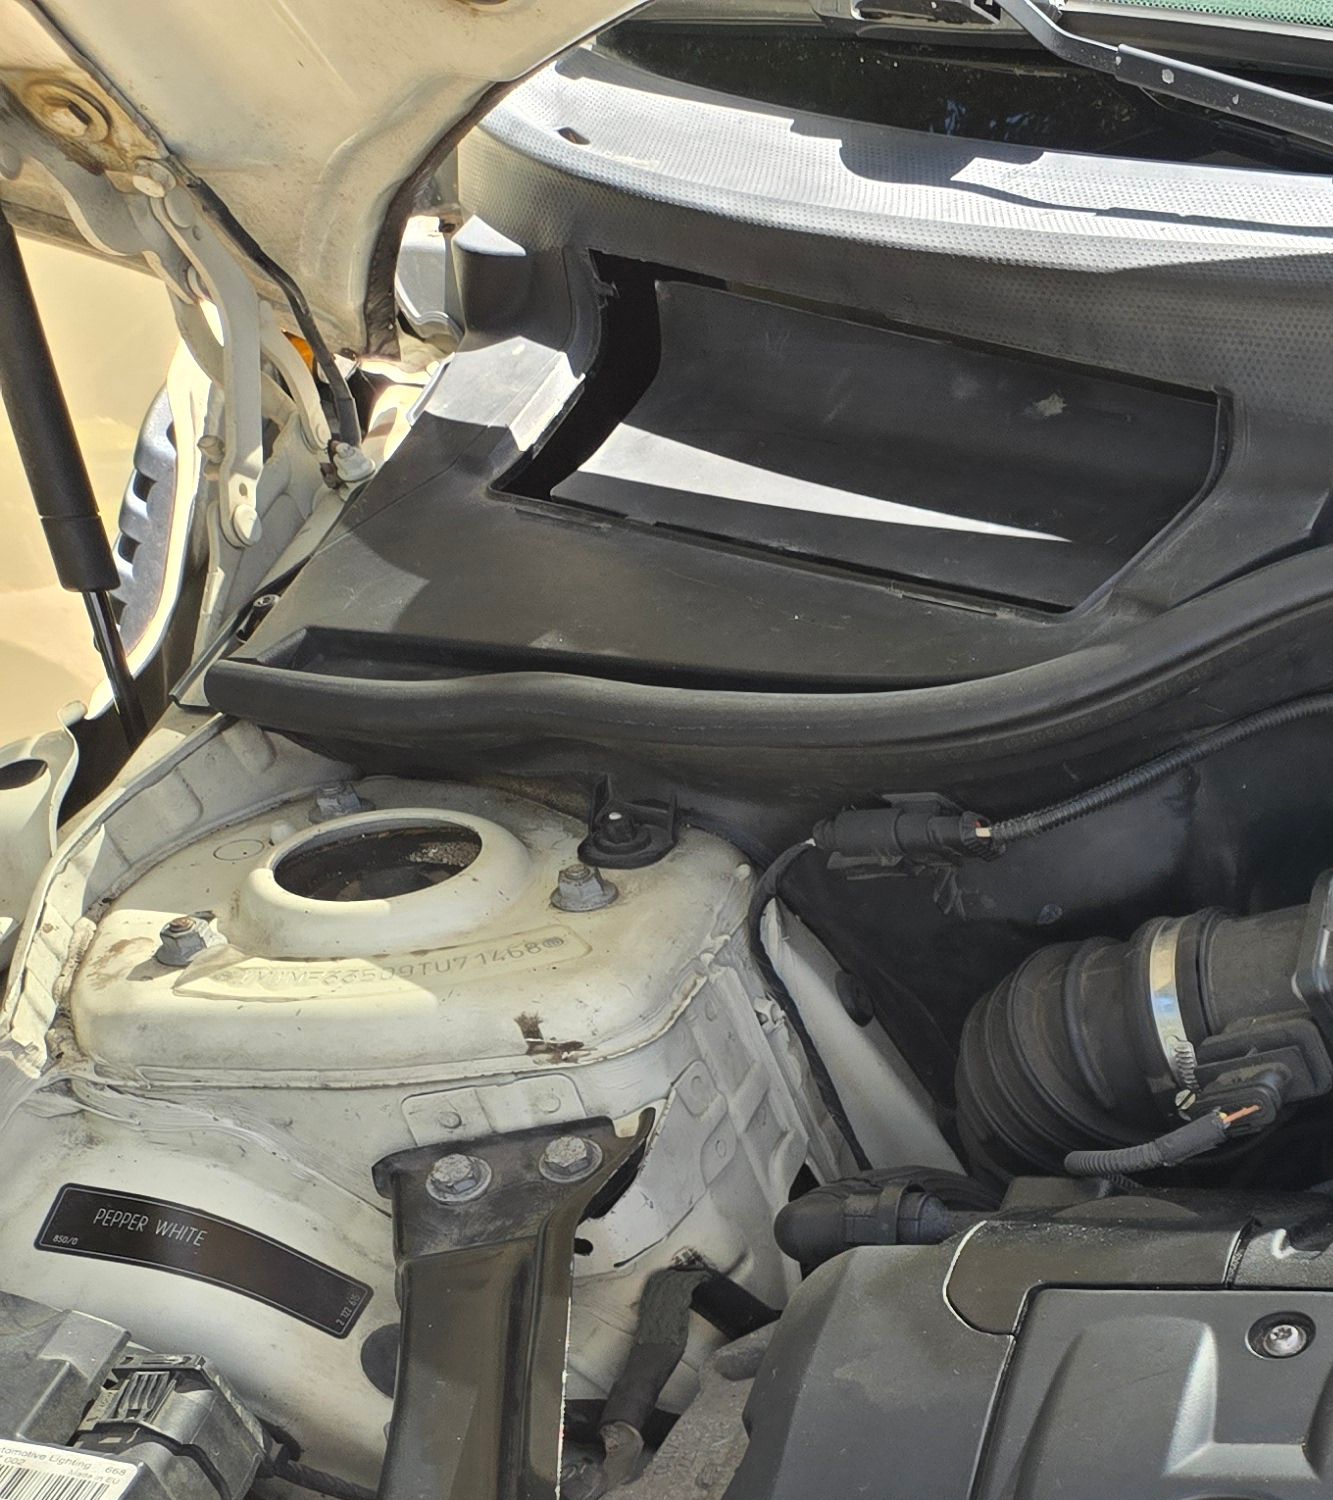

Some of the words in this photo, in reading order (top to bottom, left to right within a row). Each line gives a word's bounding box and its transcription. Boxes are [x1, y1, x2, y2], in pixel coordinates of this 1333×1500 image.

[93, 1208, 149, 1232] PEPPER
[155, 1219, 208, 1246] WHITE
[49, 1455, 92, 1471] Lighting
